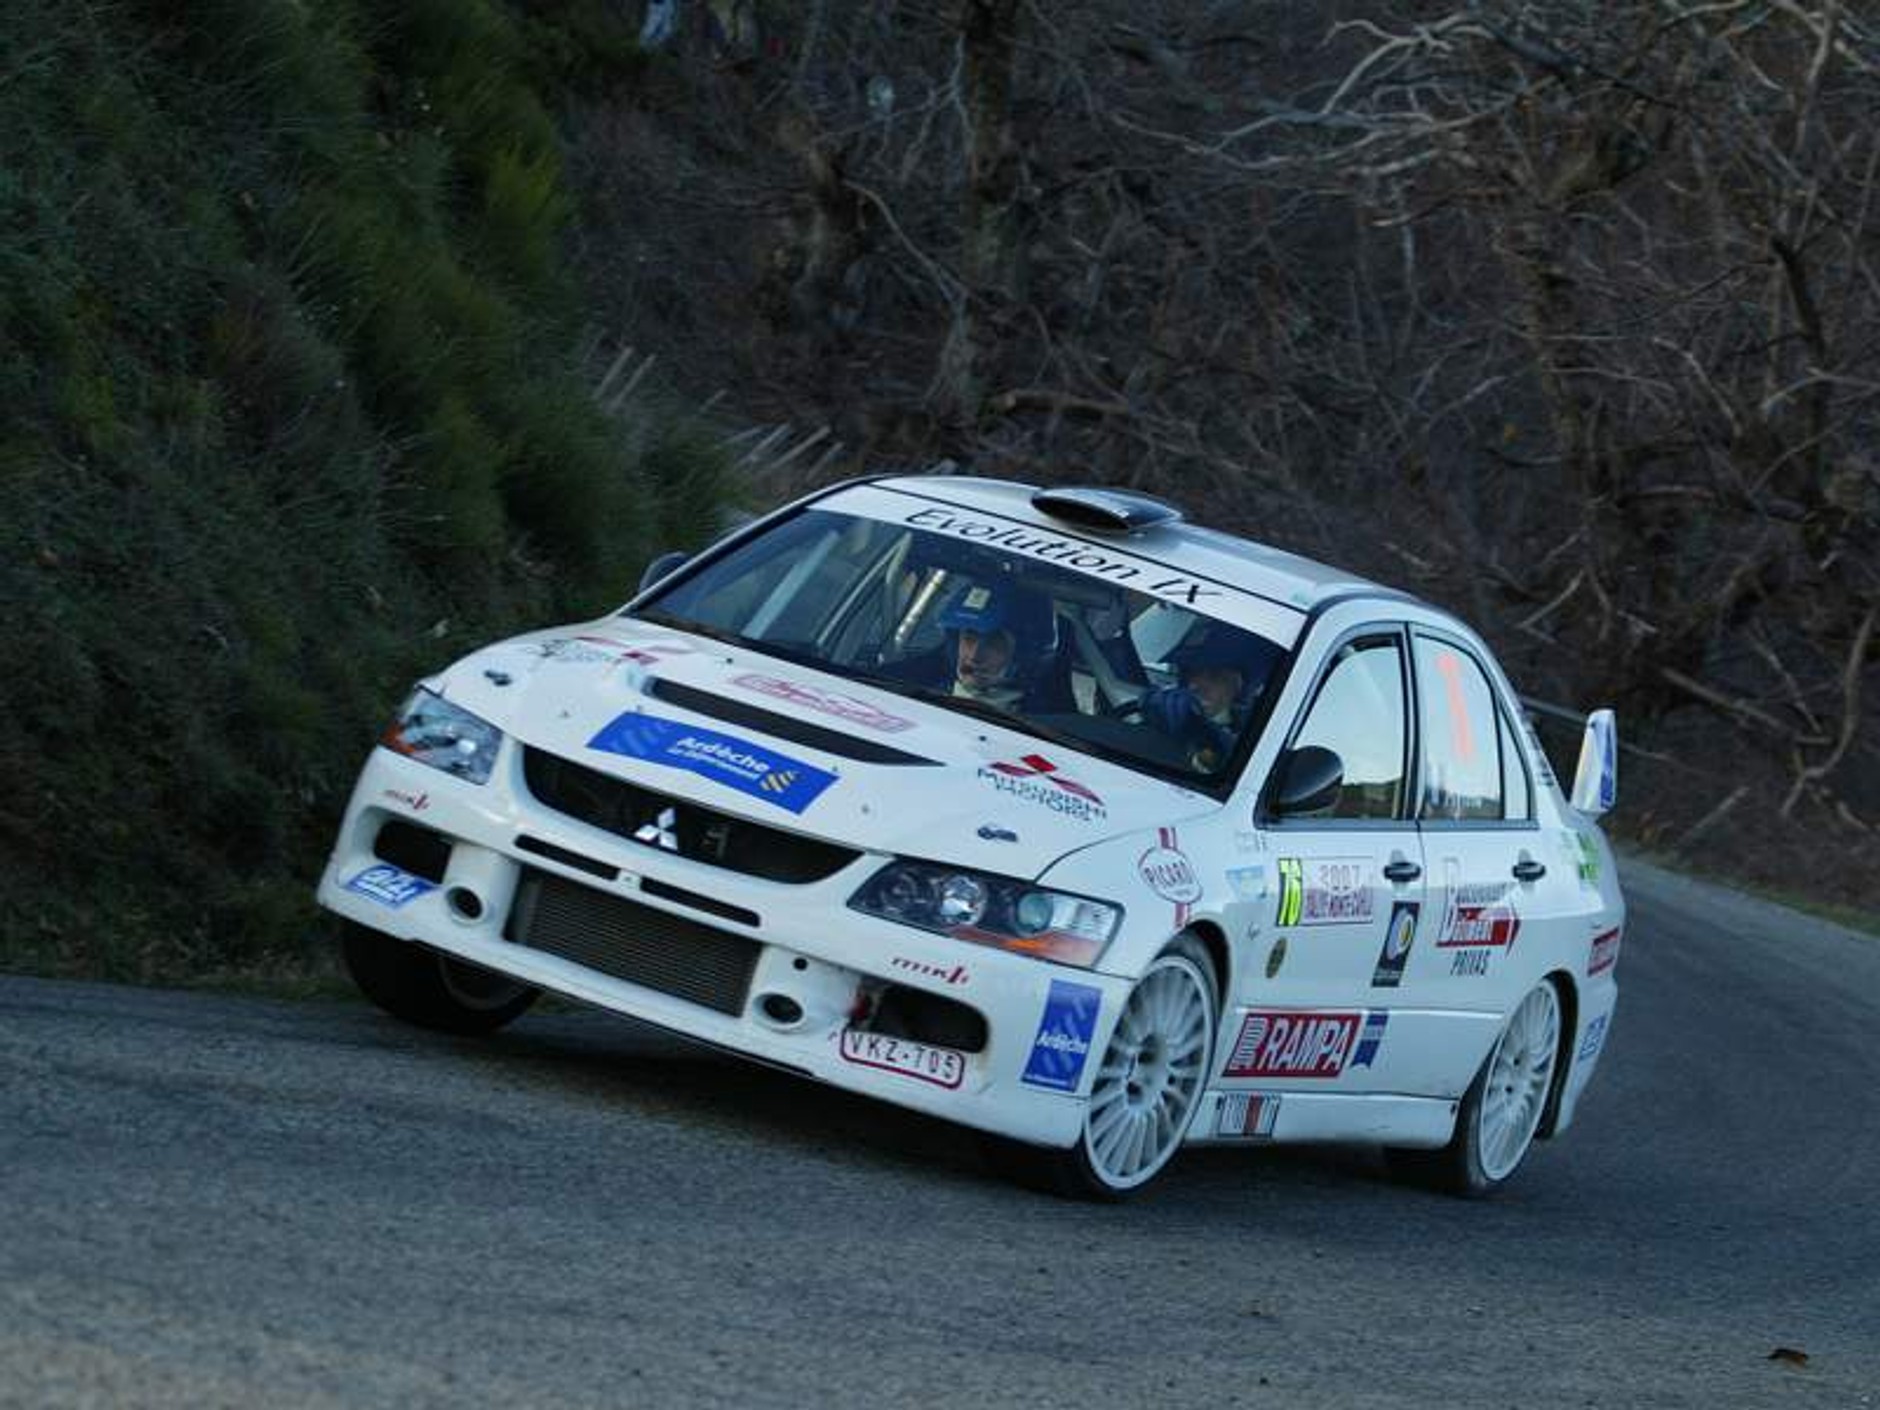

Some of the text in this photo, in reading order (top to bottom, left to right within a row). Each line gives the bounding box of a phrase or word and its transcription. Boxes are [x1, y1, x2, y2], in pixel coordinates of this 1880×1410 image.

[905, 508, 1223, 604] Evolution IX
[676, 736, 771, 773] Ardèche
[1319, 863, 1361, 890] 2007
[1257, 1017, 1352, 1071] RAMPA
